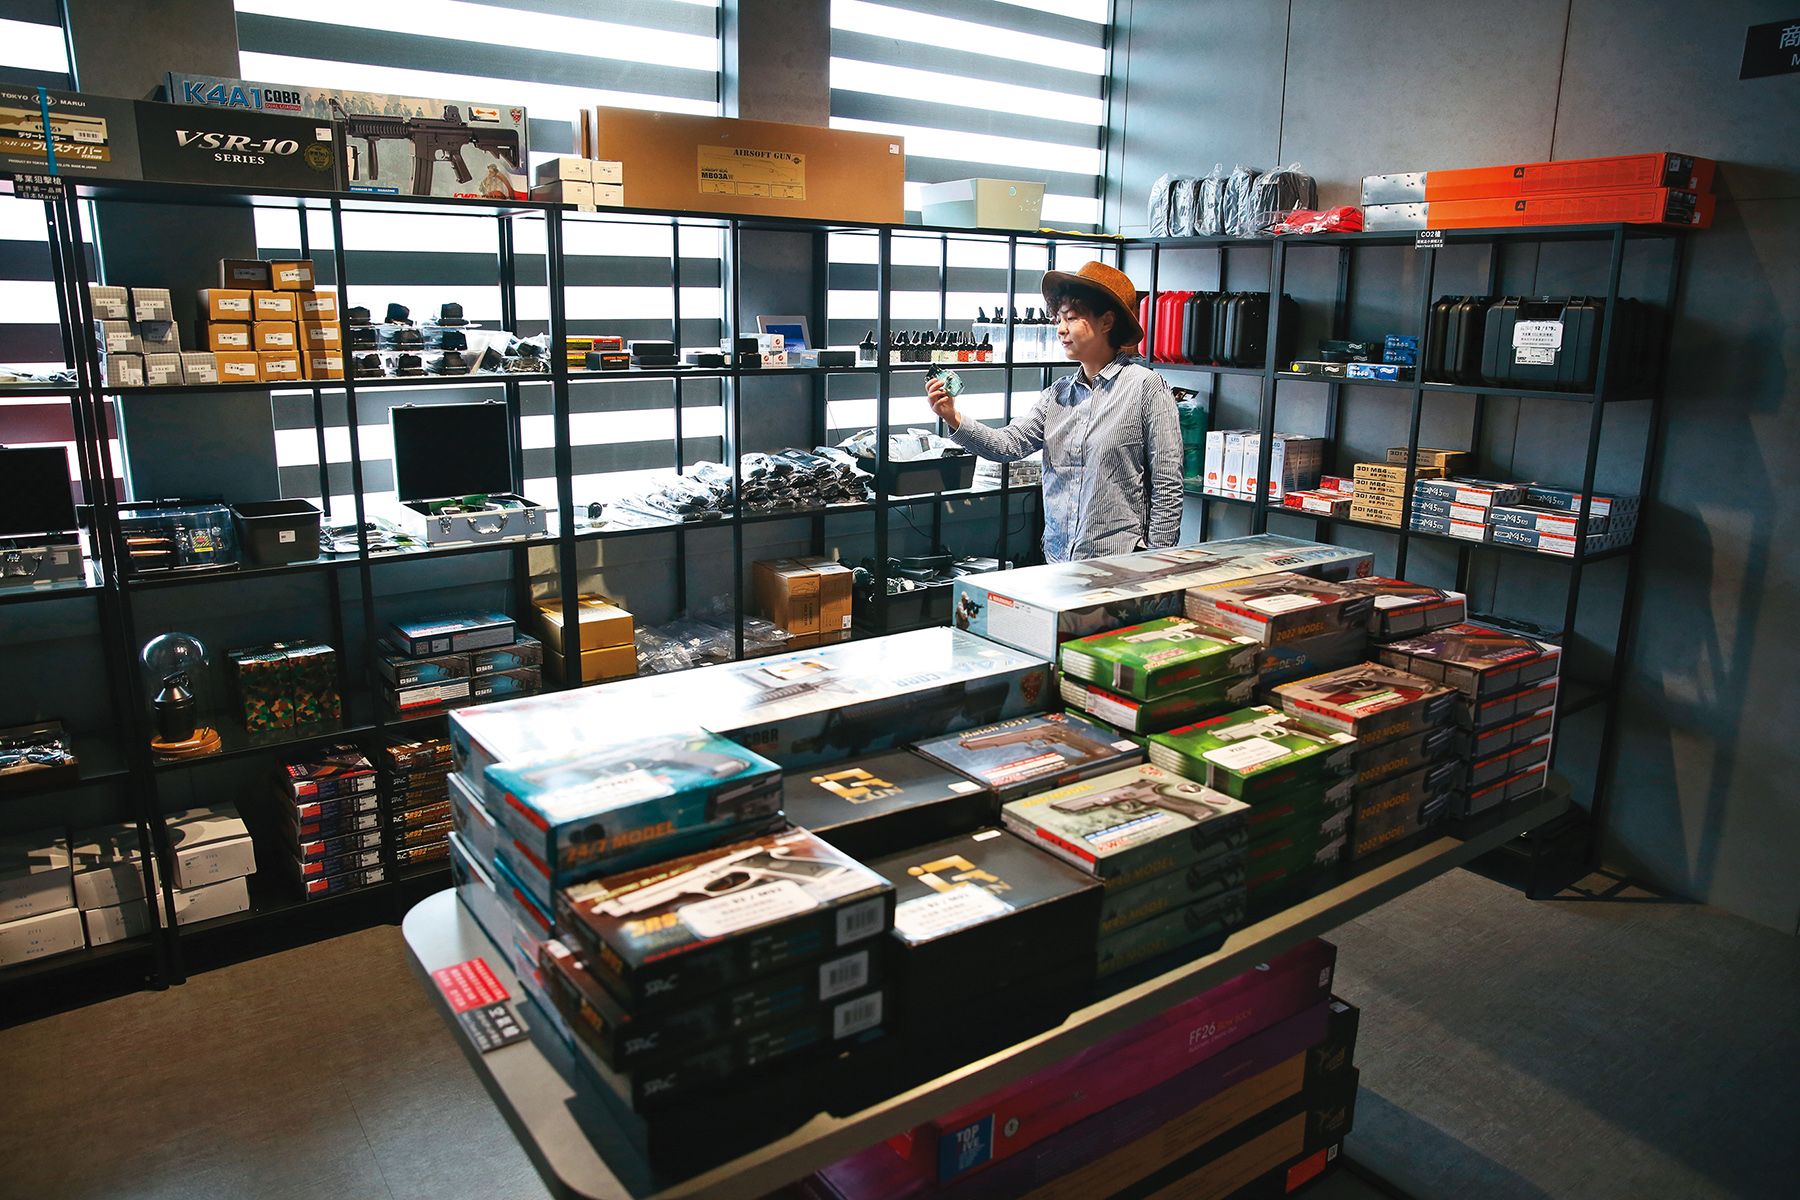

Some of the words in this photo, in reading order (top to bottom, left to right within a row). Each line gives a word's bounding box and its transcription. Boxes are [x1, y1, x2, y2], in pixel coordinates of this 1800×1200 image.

[1, 92, 28, 100] TOKYO
[60, 99, 86, 107] MARUI
[183, 81, 263, 109] K4A1
[18, 131, 66, 141] デザートラー
[175, 130, 299, 156] VSR-10
[215, 153, 265, 165] SERIES
[733, 149, 772, 158] AIRSOFT
[1297, 621, 1324, 635] MODEL
[959, 726, 999, 739] Match
[1000, 718, 1030, 729] 1911
[1381, 721, 1410, 737] MODEL
[1381, 756, 1409, 774] MODEL
[1049, 784, 1095, 800] MODEL
[1381, 792, 1410, 809] MODEL
[612, 820, 677, 850] MODEL
[1377, 825, 1405, 843] MODEL
[1189, 1021, 1216, 1046] FF26
[956, 1124, 980, 1142] TOP
